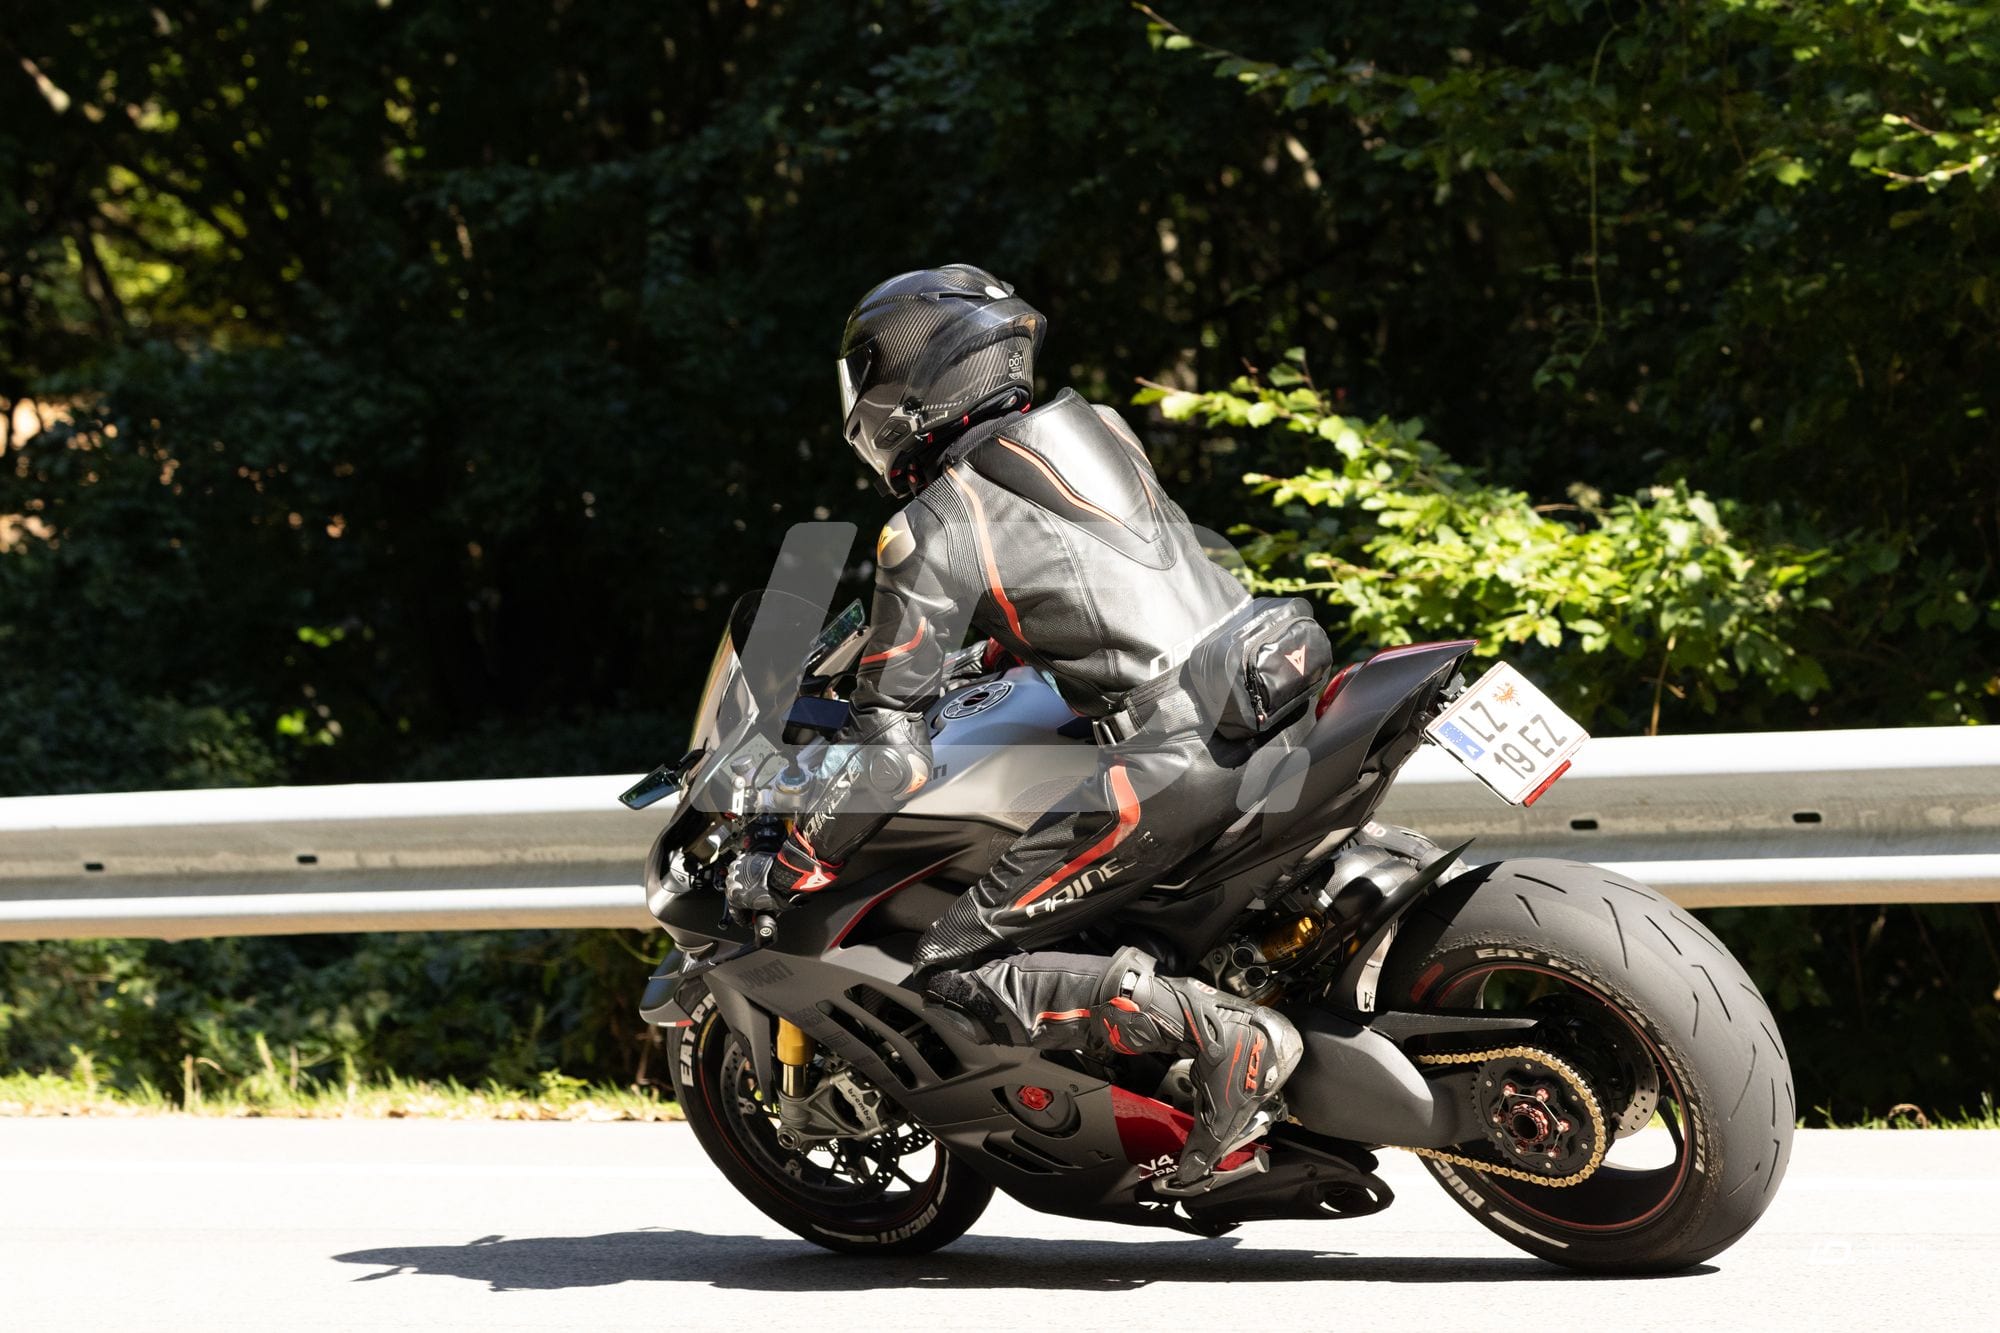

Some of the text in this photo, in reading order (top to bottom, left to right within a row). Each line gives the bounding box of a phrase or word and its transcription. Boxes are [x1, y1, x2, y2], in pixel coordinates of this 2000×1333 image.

[1458, 700, 1508, 743] LZ
[1493, 714, 1567, 780] 19 EZ
[1476, 948, 1537, 960] EAT
[679, 1026, 696, 1087] EAT
[847, 1088, 872, 1121] brembo
[1138, 1154, 1175, 1171] V4
[880, 1203, 938, 1244] DUCATI
